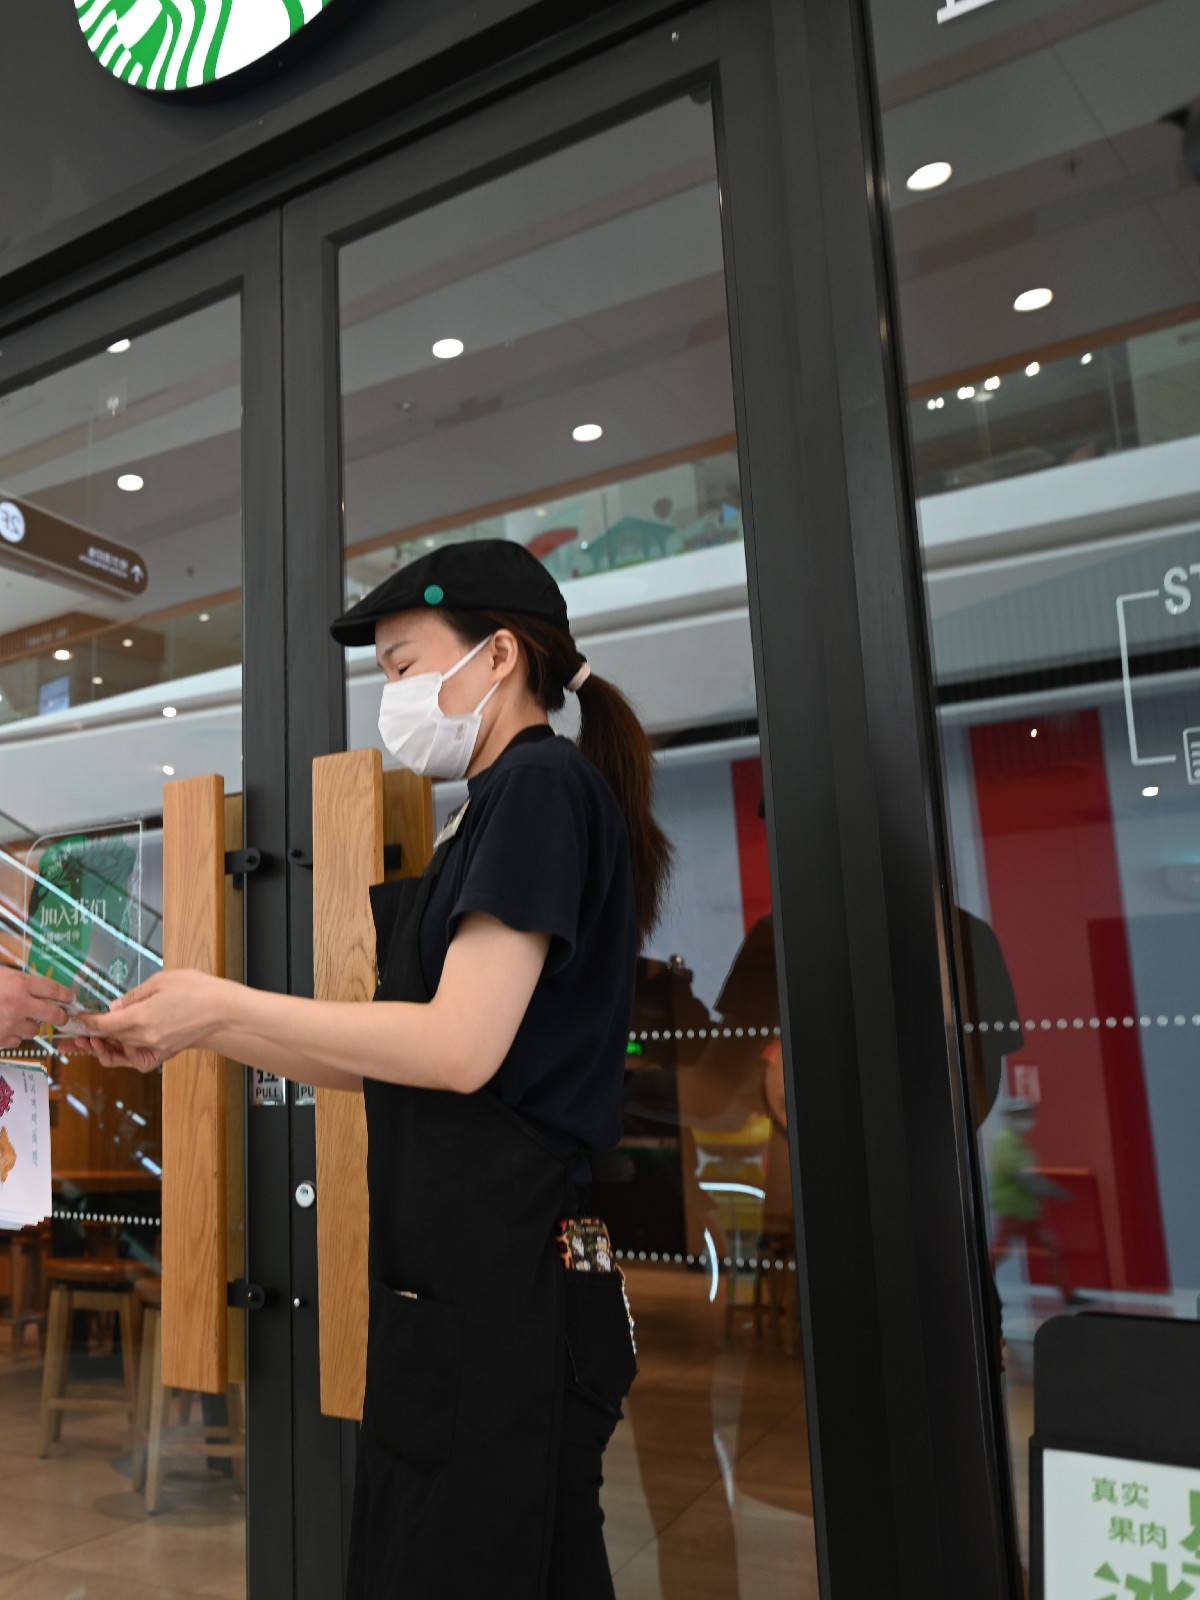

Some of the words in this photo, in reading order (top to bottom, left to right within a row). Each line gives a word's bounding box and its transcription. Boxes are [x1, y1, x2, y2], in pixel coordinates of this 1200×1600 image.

[40, 897, 106, 927] 加入我们
[255, 1086, 279, 1098] PULL
[1091, 1477, 1149, 1509] 真实
[1108, 1516, 1167, 1550] 果肉
